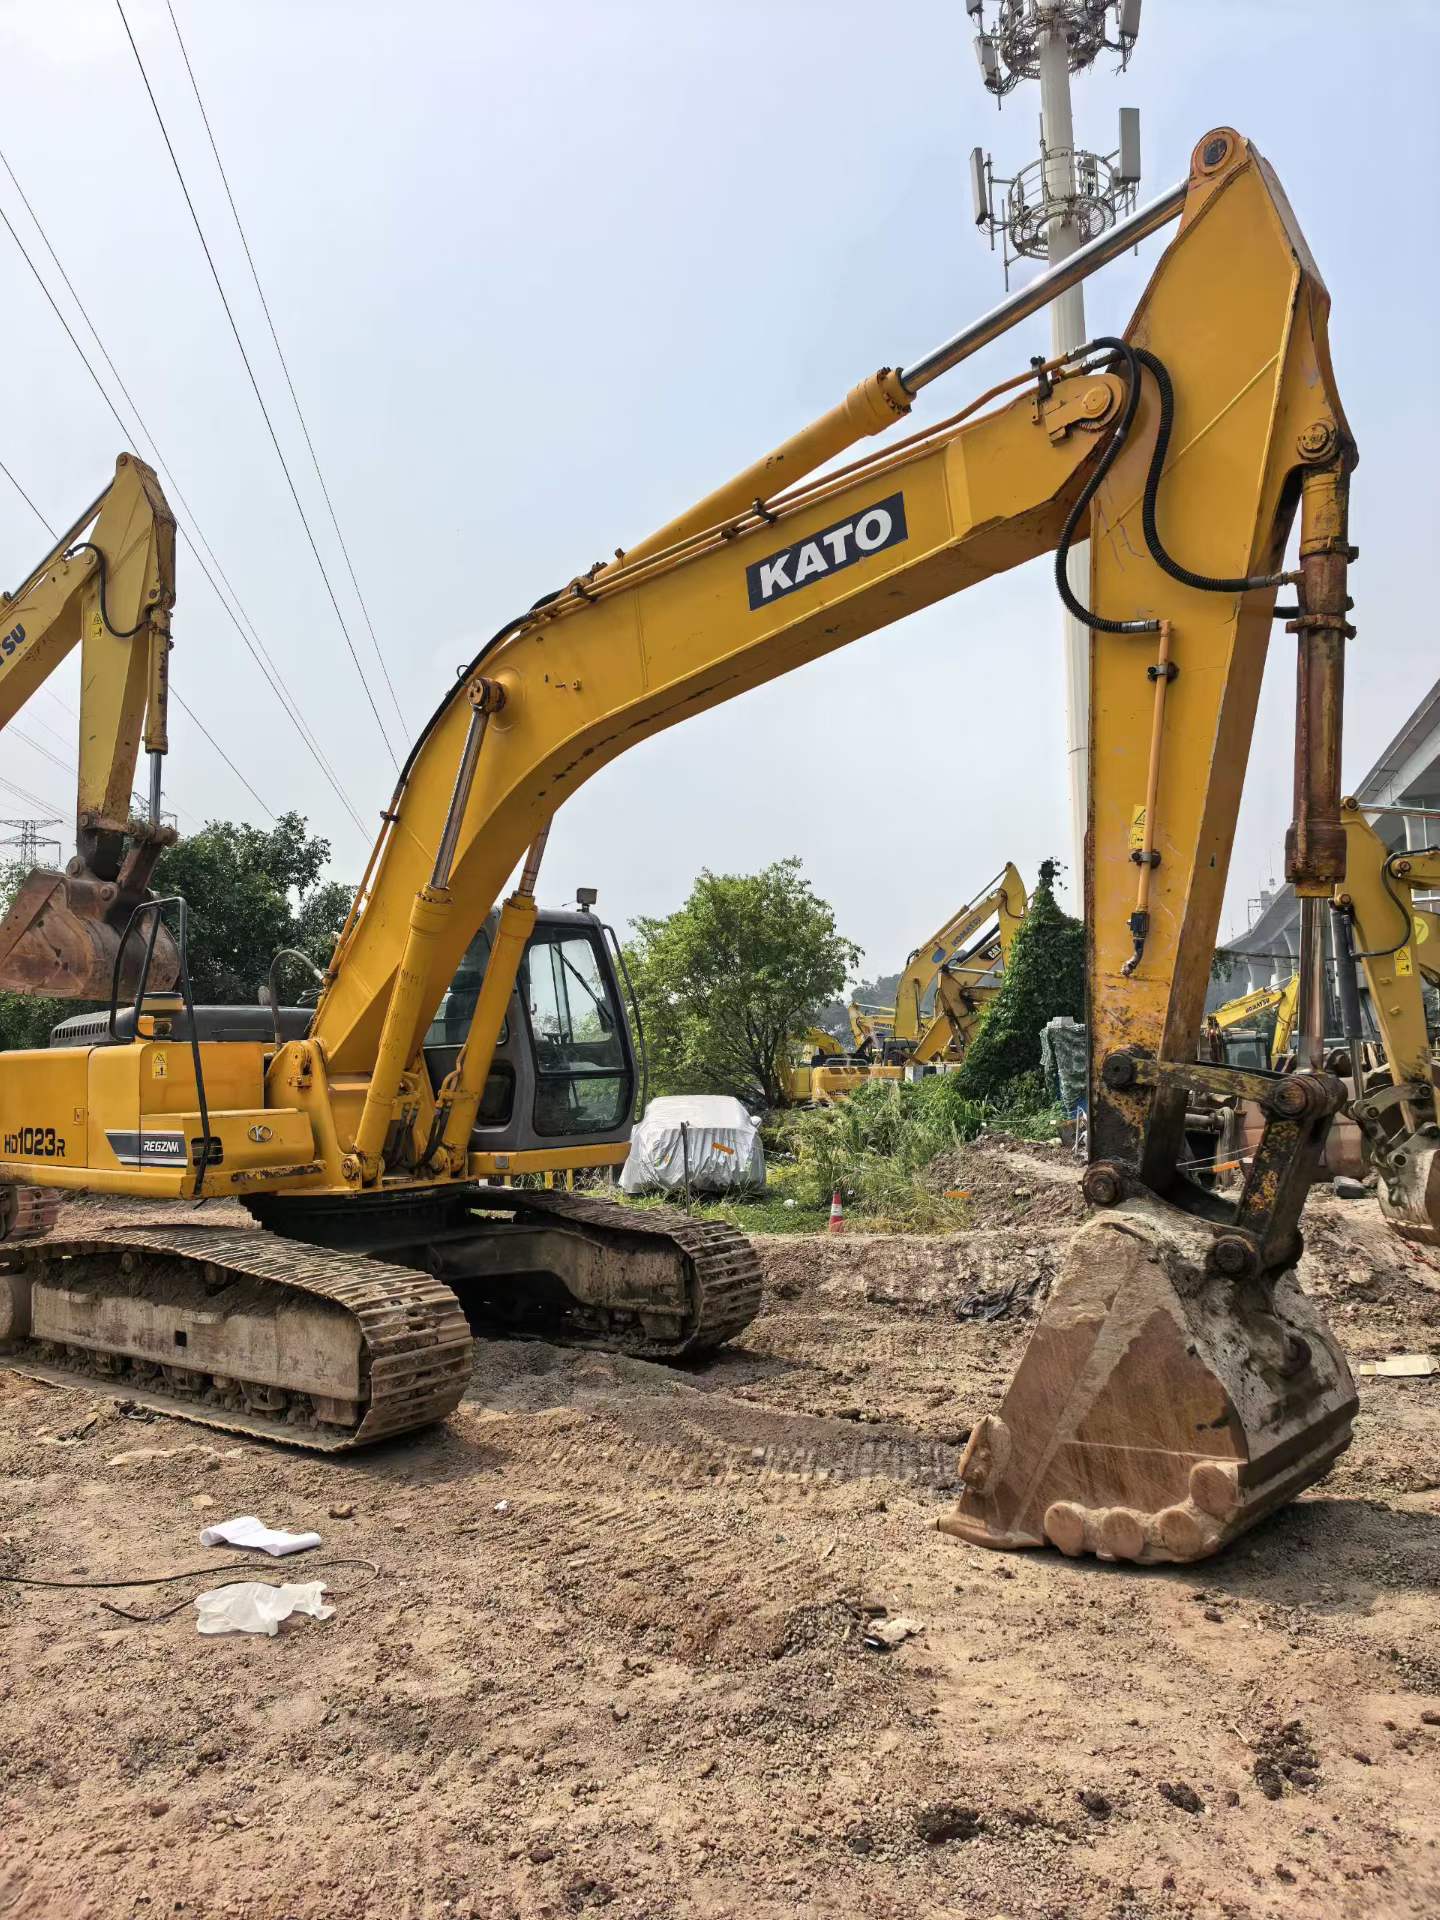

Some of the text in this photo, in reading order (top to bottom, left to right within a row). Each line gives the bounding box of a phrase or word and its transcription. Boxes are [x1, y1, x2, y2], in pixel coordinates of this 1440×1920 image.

[759, 508, 893, 599] KATO
[0, 623, 26, 666] SU
[987, 944, 1001, 959] CAT
[143, 1140, 180, 1153] REGZAM
